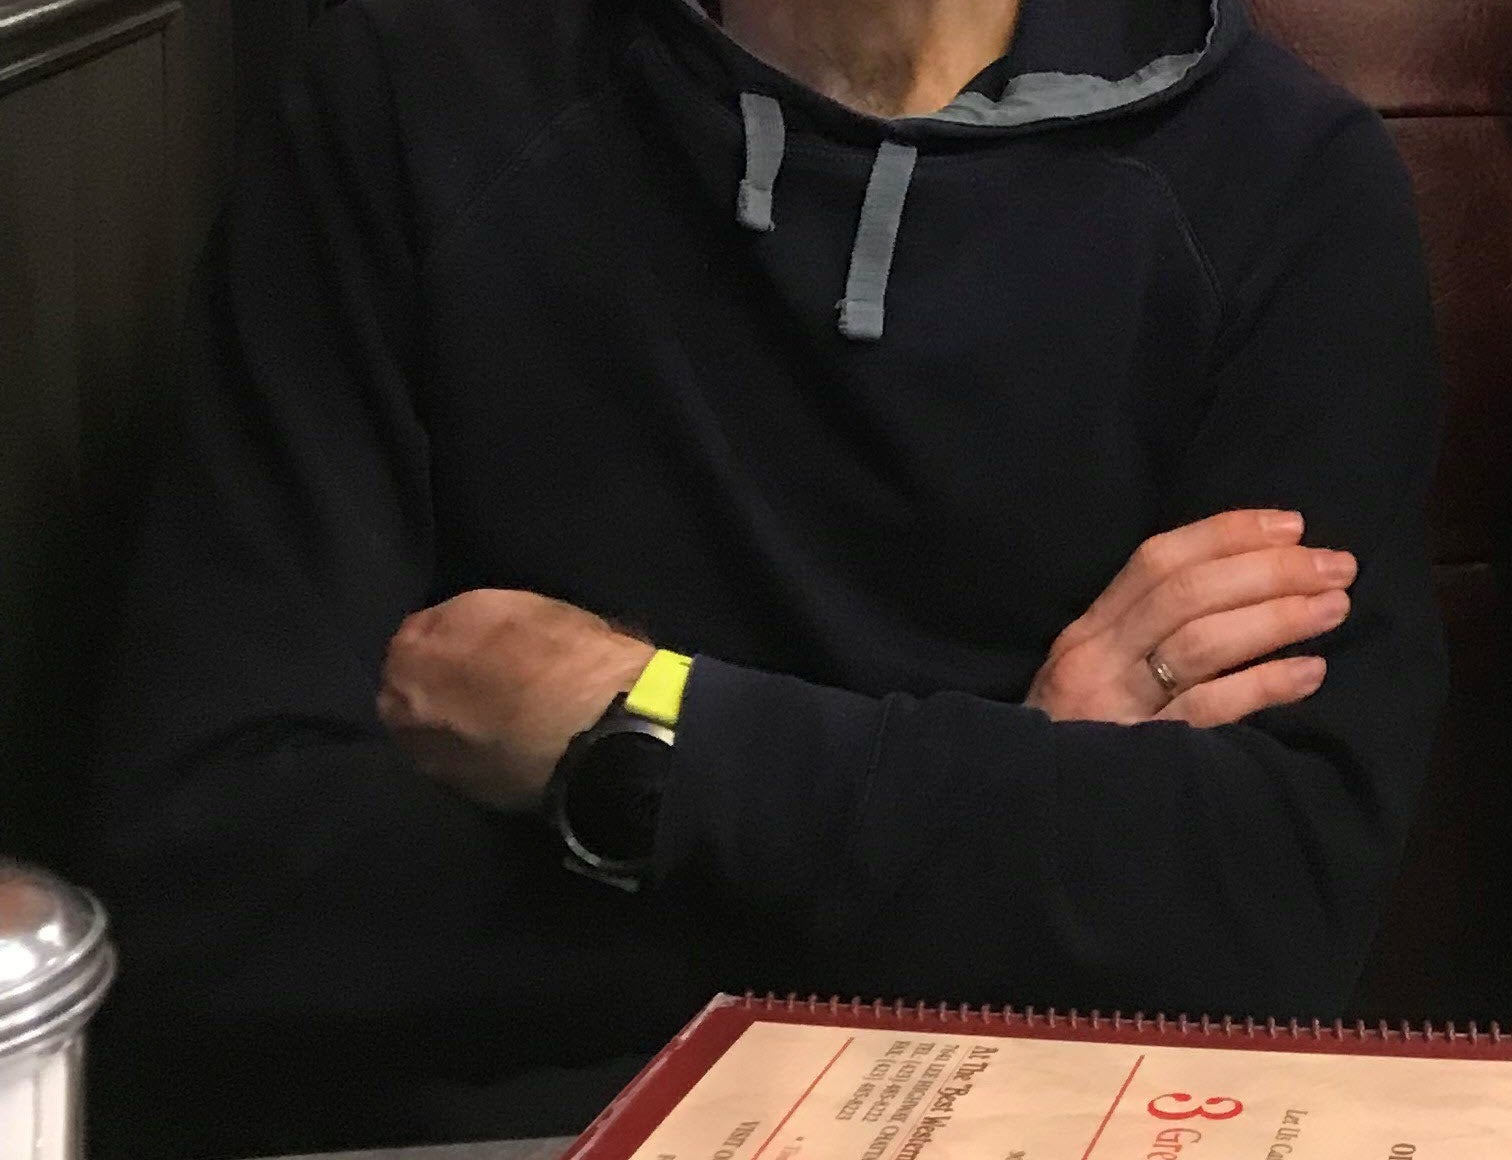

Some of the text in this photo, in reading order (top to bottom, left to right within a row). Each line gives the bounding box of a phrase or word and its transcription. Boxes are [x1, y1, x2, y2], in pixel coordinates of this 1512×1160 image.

[969, 1045, 999, 1059] At
[953, 1062, 989, 1080] The
[1147, 1093, 1243, 1120] 3
[1282, 1109, 1309, 1124] Let
[722, 1120, 761, 1147] VISIT
[1274, 1127, 1301, 1140] Us
